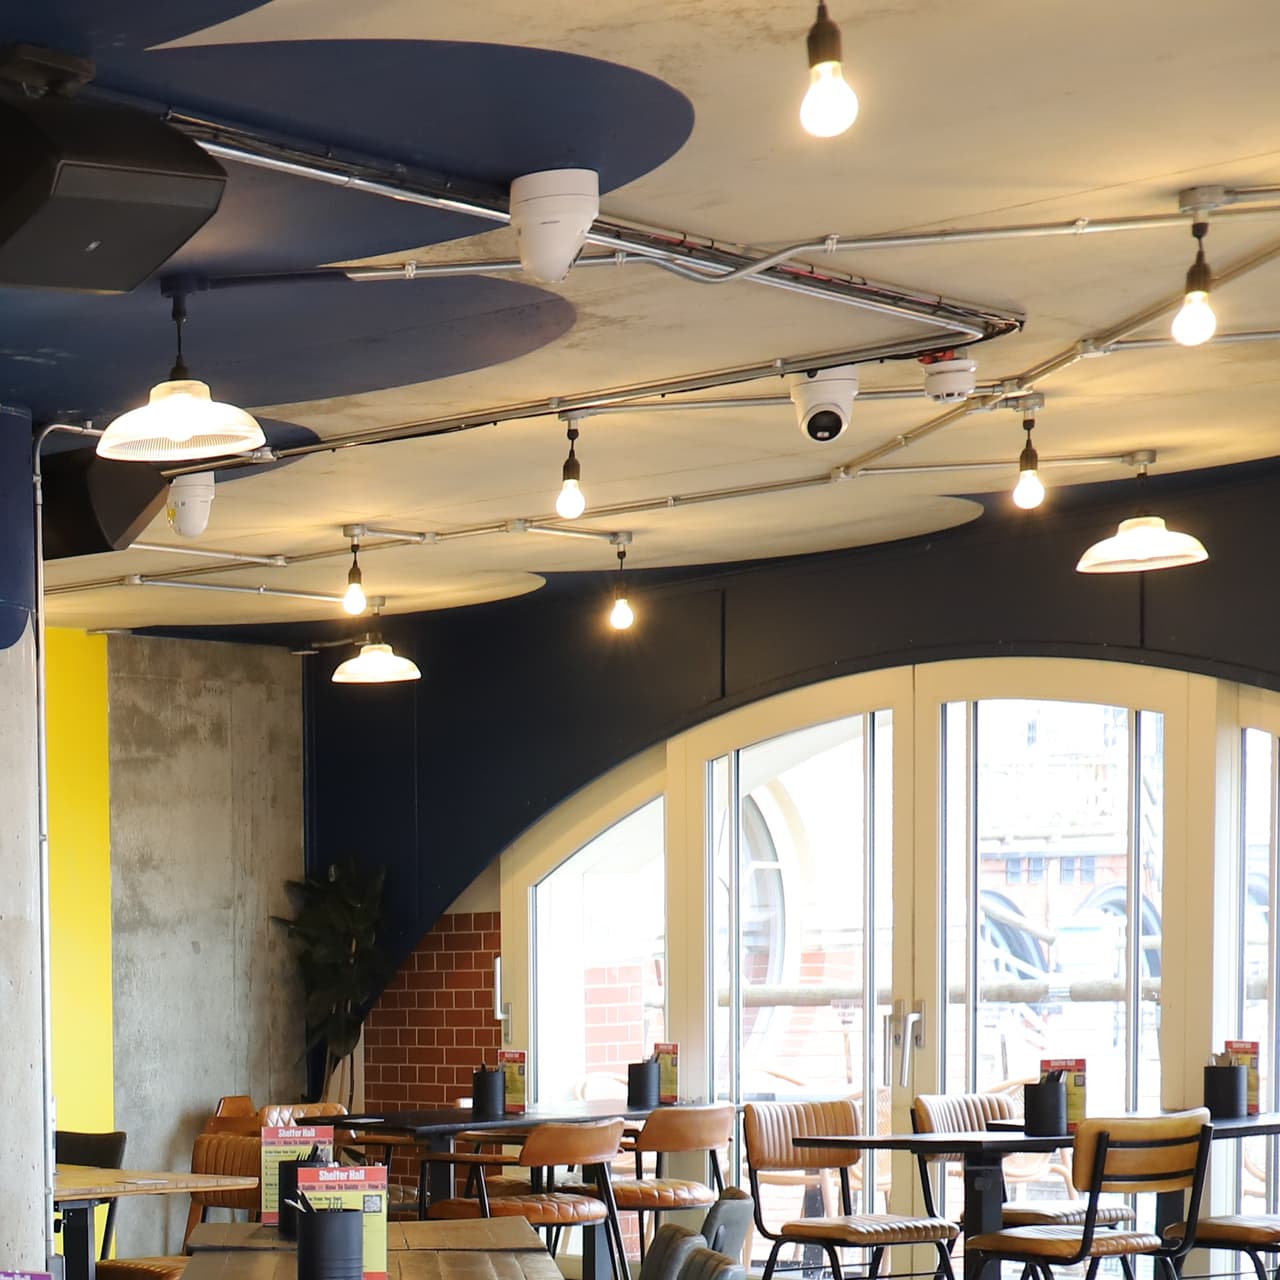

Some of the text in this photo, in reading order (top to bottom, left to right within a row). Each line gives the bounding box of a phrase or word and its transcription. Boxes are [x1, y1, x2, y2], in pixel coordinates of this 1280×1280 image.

[278, 1128, 315, 1137] Shelter Hall
[319, 1170, 365, 1181] Shelter Hall
